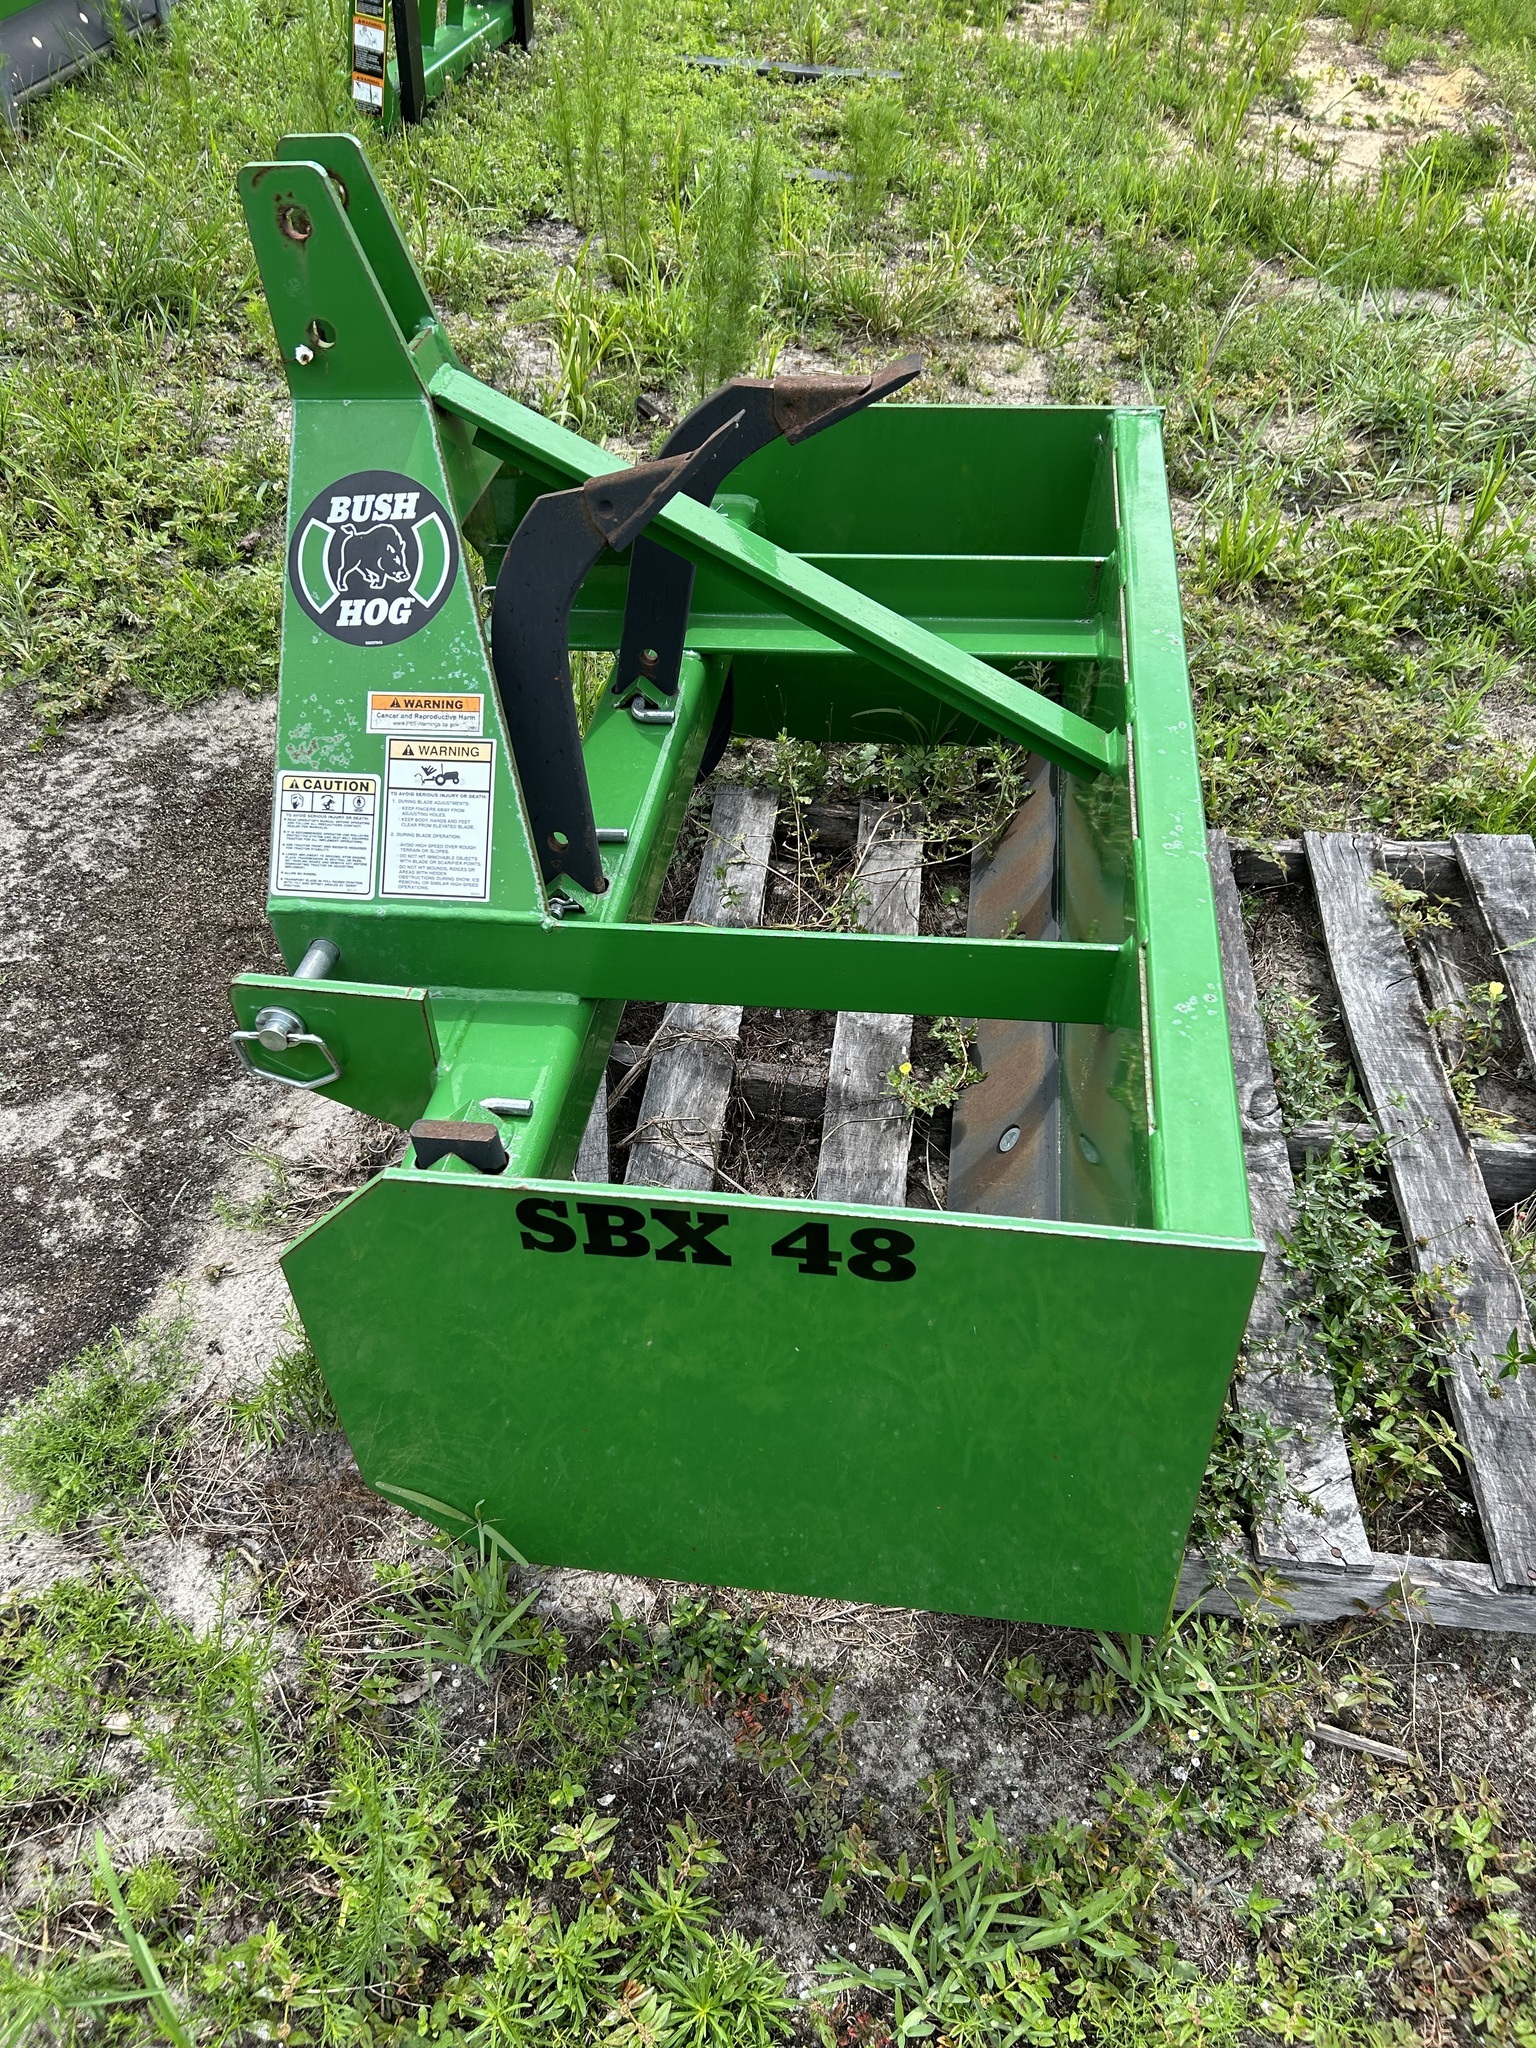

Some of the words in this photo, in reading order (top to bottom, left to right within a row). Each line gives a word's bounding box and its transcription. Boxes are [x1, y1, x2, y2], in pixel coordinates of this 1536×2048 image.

[326, 492, 420, 523] BUSH
[336, 597, 414, 626] HOG
[404, 699, 464, 709] WARNING
[418, 745, 480, 757] WARNING
[303, 779, 370, 792] CAUTION
[515, 1196, 732, 1266] SBX
[771, 1222, 917, 1282] 48
